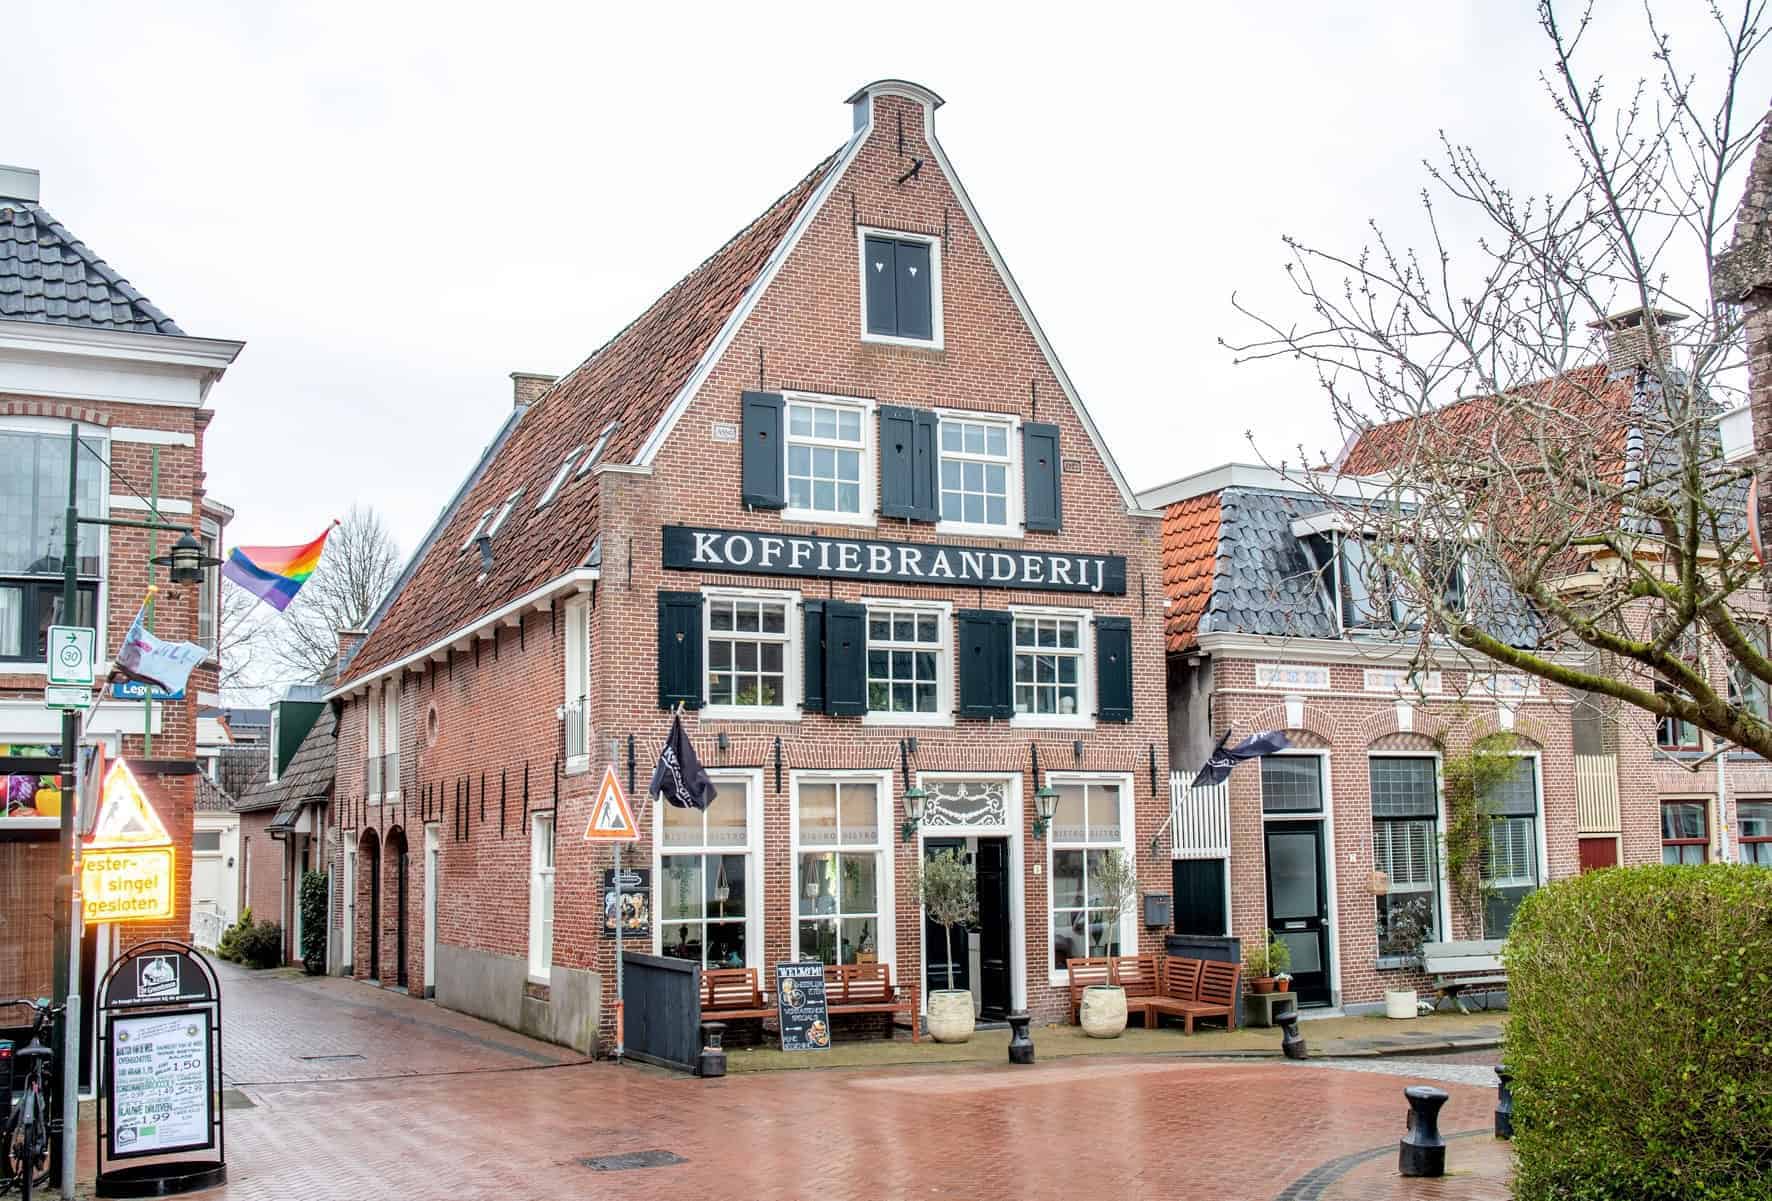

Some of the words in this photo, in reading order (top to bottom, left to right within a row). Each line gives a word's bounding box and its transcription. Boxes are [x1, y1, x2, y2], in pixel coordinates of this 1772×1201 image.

[691, 531, 1106, 593] KOFFIEBRANDERIJ
[64, 651, 79, 662] 30
[841, 831, 878, 841] BISTRO
[108, 874, 159, 894] singel
[88, 896, 159, 916] gesloten
[173, 1059, 201, 1072] 1,50
[142, 1112, 170, 1125] 1,99
